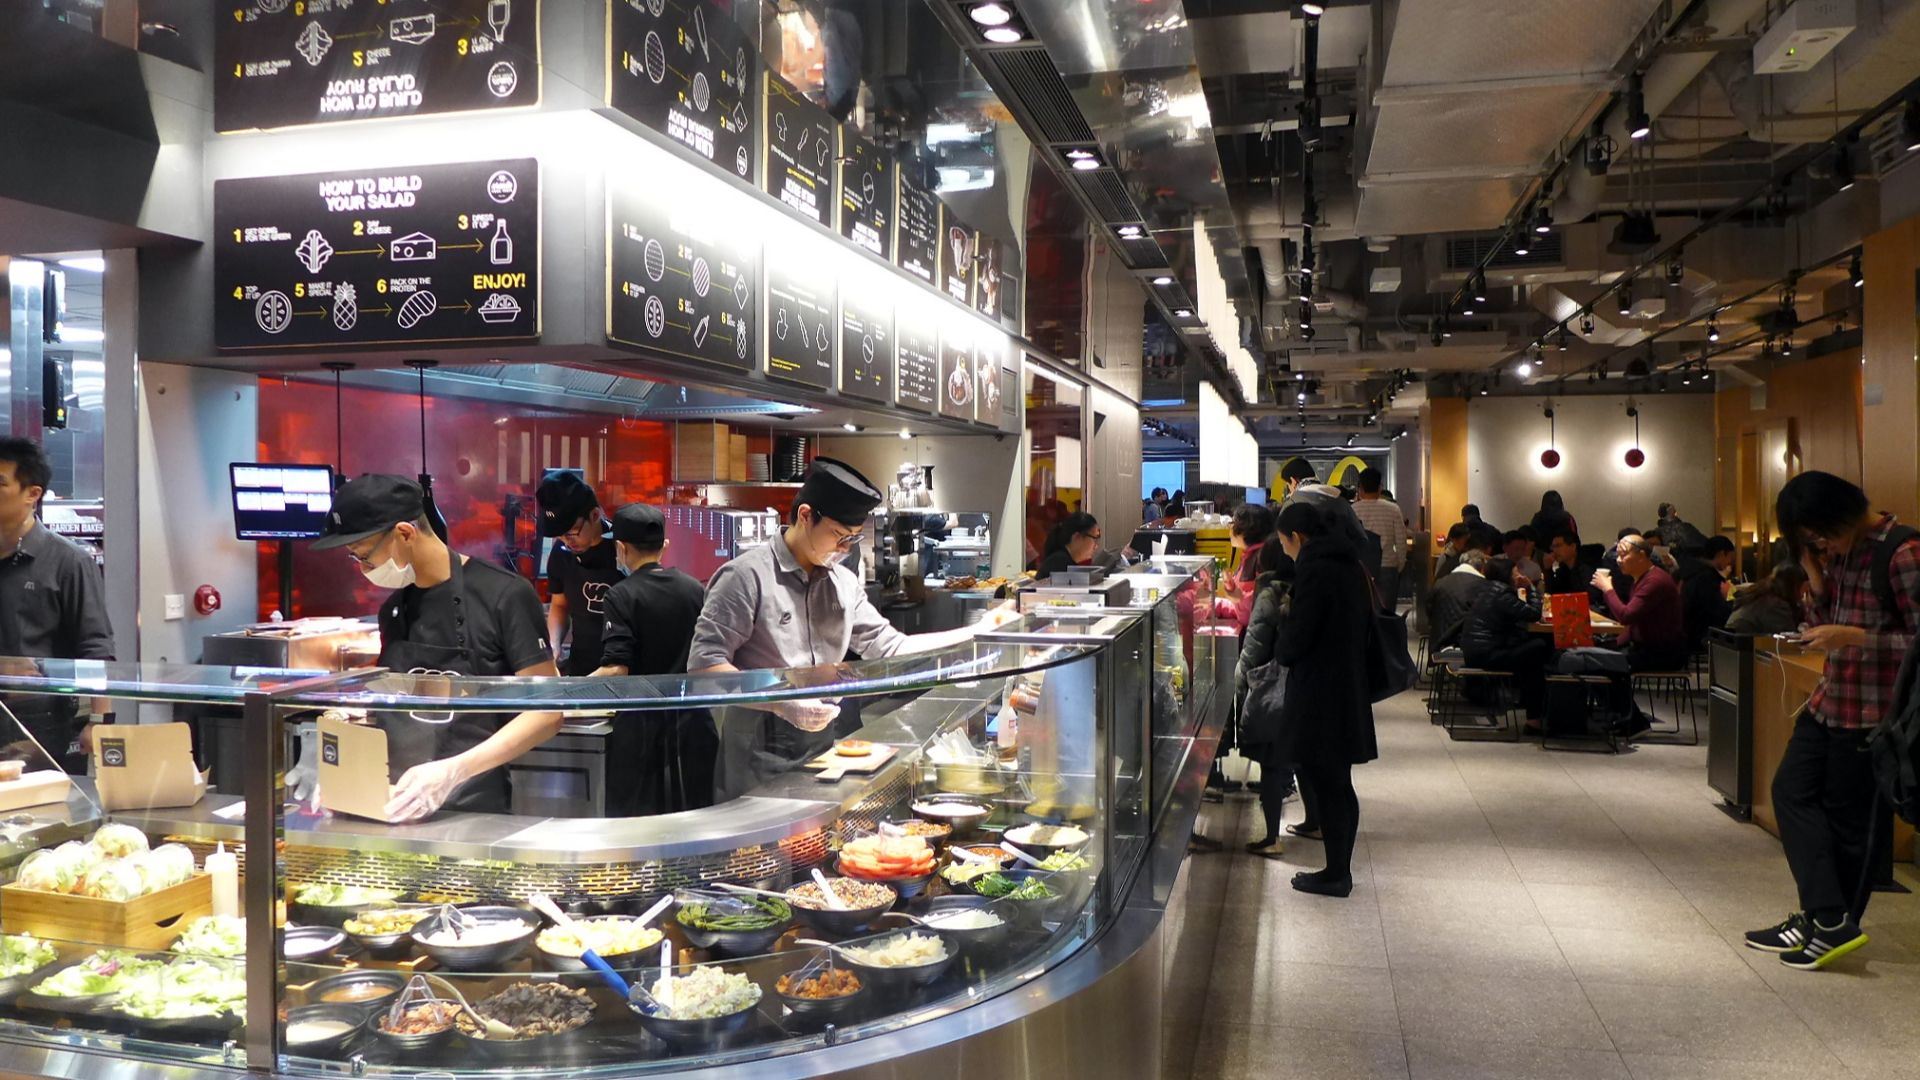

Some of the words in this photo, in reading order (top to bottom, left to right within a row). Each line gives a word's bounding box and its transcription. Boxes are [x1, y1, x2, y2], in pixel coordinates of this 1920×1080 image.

[319, 179, 354, 197] HOW
[355, 177, 376, 194] TO
[378, 174, 422, 192] BUILD
[325, 194, 365, 212] YOUR
[367, 192, 416, 209] SALAD
[352, 220, 364, 236] 2
[457, 214, 469, 230] 3
[233, 228, 242, 243] 1
[366, 226, 392, 235] CHEESE
[308, 282, 325, 291] MAKE
[376, 278, 387, 293] 6
[390, 278, 407, 286] PACK
[407, 277, 418, 285] ON
[418, 276, 431, 285] THE
[473, 272, 526, 290] ENJOY!
[233, 286, 243, 300] 4
[294, 283, 305, 298] 5
[308, 289, 333, 298] SPECIAL
[390, 284, 417, 293] PROTEIN
[622, 281, 629, 296] 4
[677, 297, 684, 311] 5
[721, 312, 727, 324] 6
[49, 523, 80, 533] GARDEN
